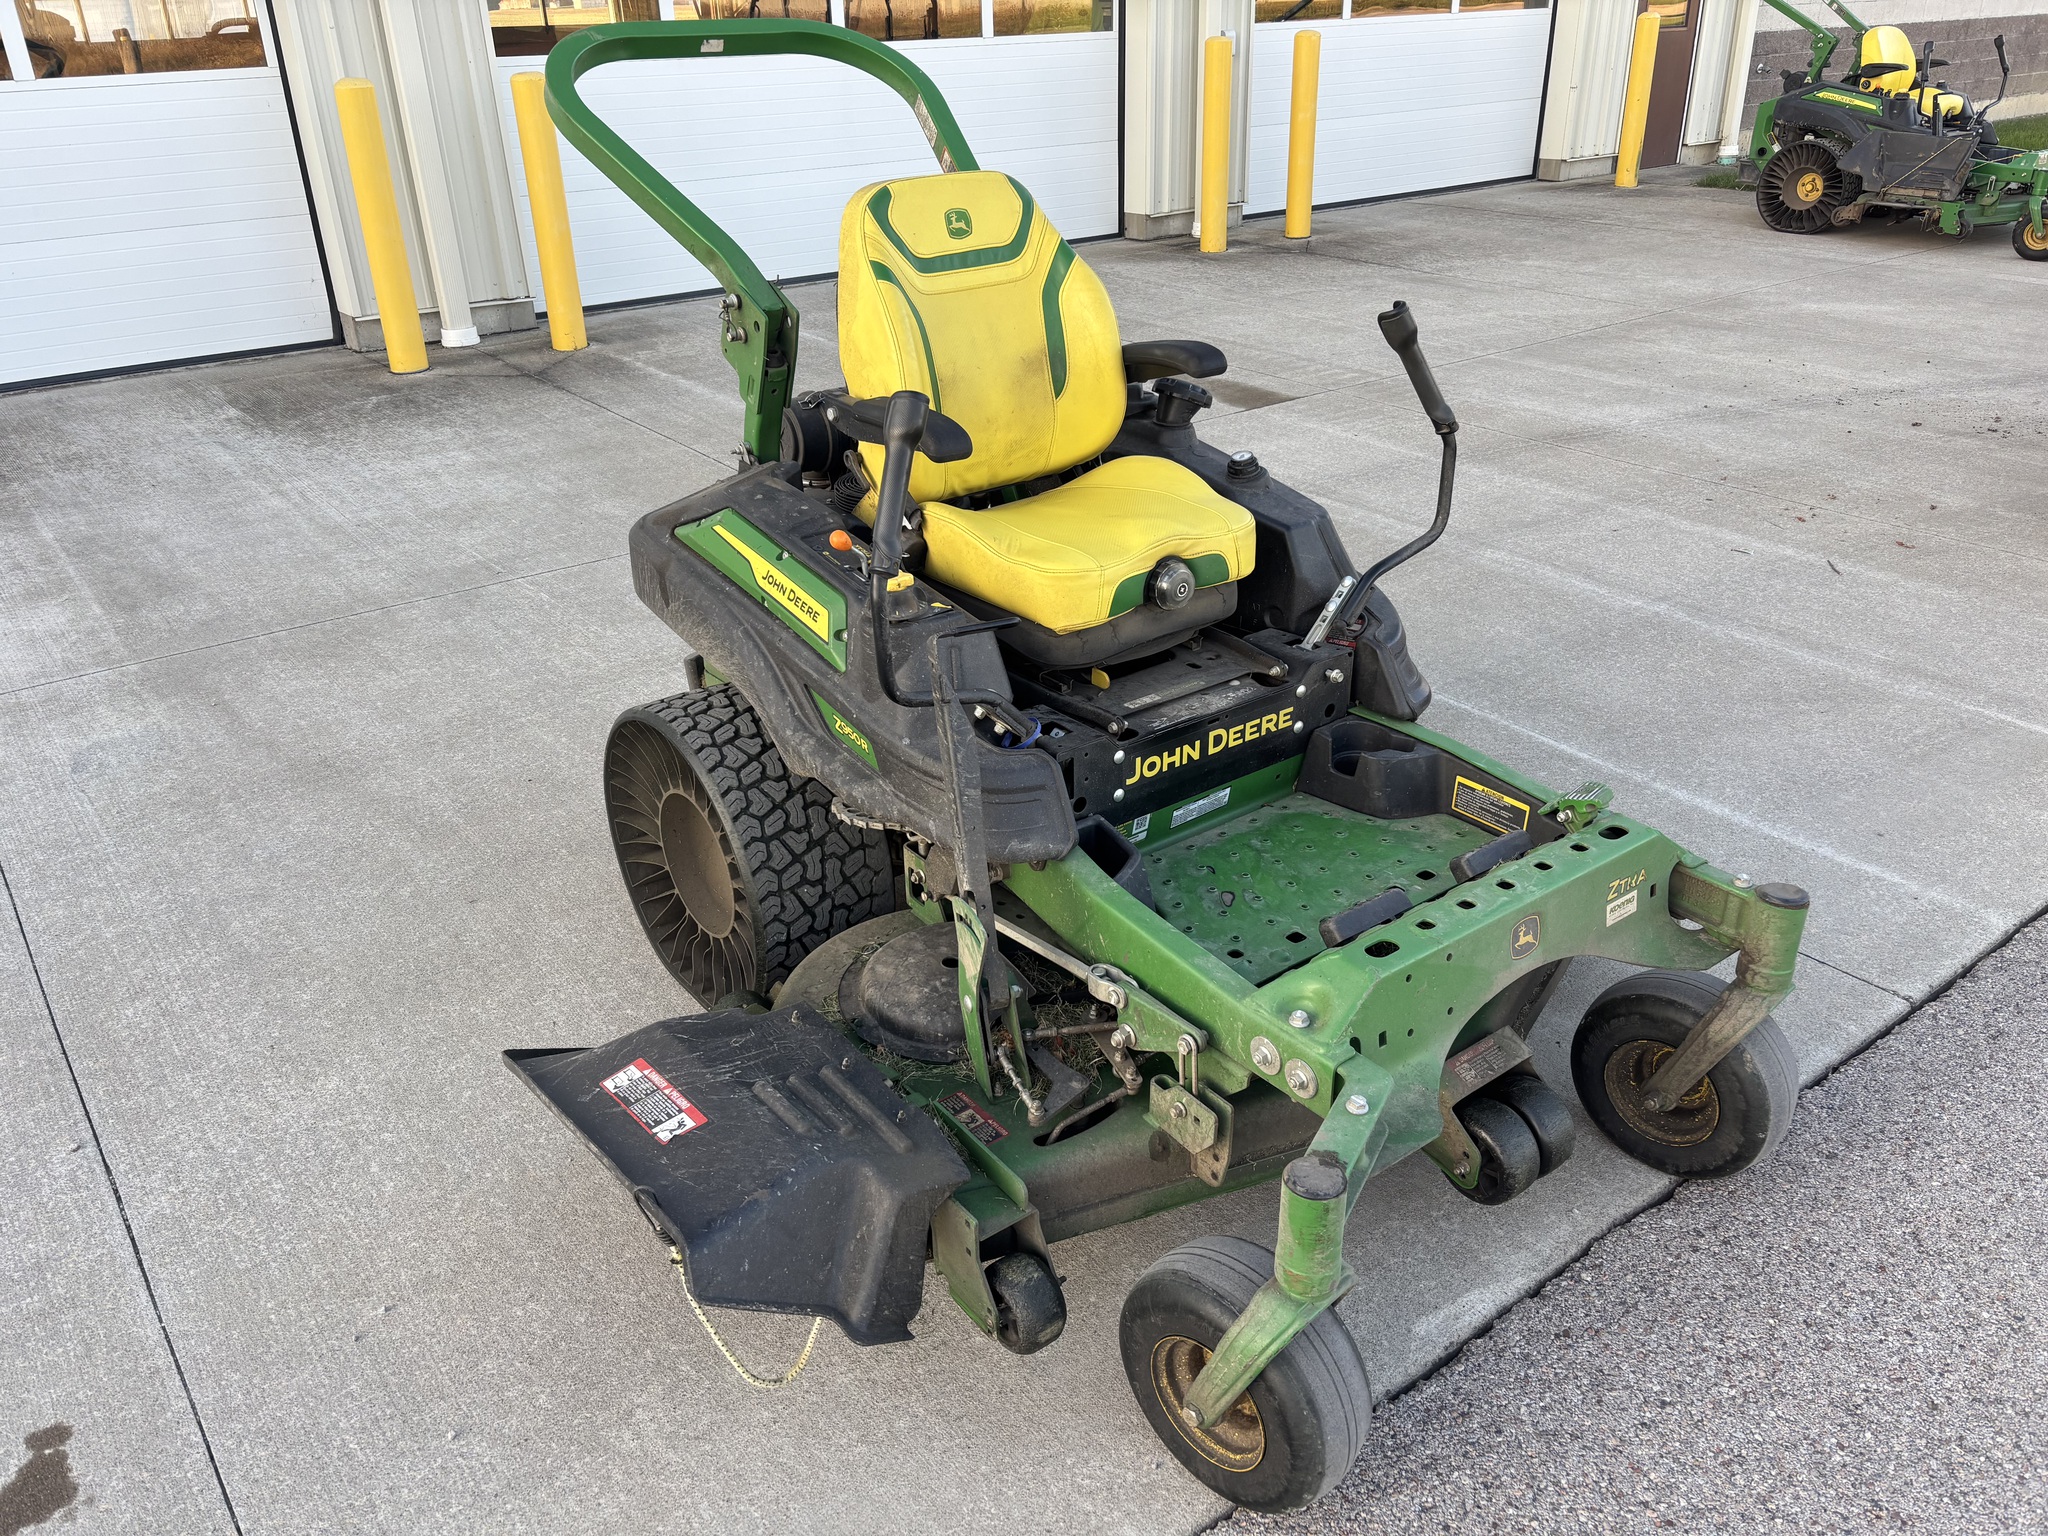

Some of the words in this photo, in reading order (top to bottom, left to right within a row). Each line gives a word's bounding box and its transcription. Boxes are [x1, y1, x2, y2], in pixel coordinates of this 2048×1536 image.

[761, 570, 788, 597] JOHN
[787, 588, 821, 623] DEERE
[831, 713, 869, 754] Z950R
[1125, 740, 1201, 786] JOHN
[1207, 706, 1295, 756] DEERE
